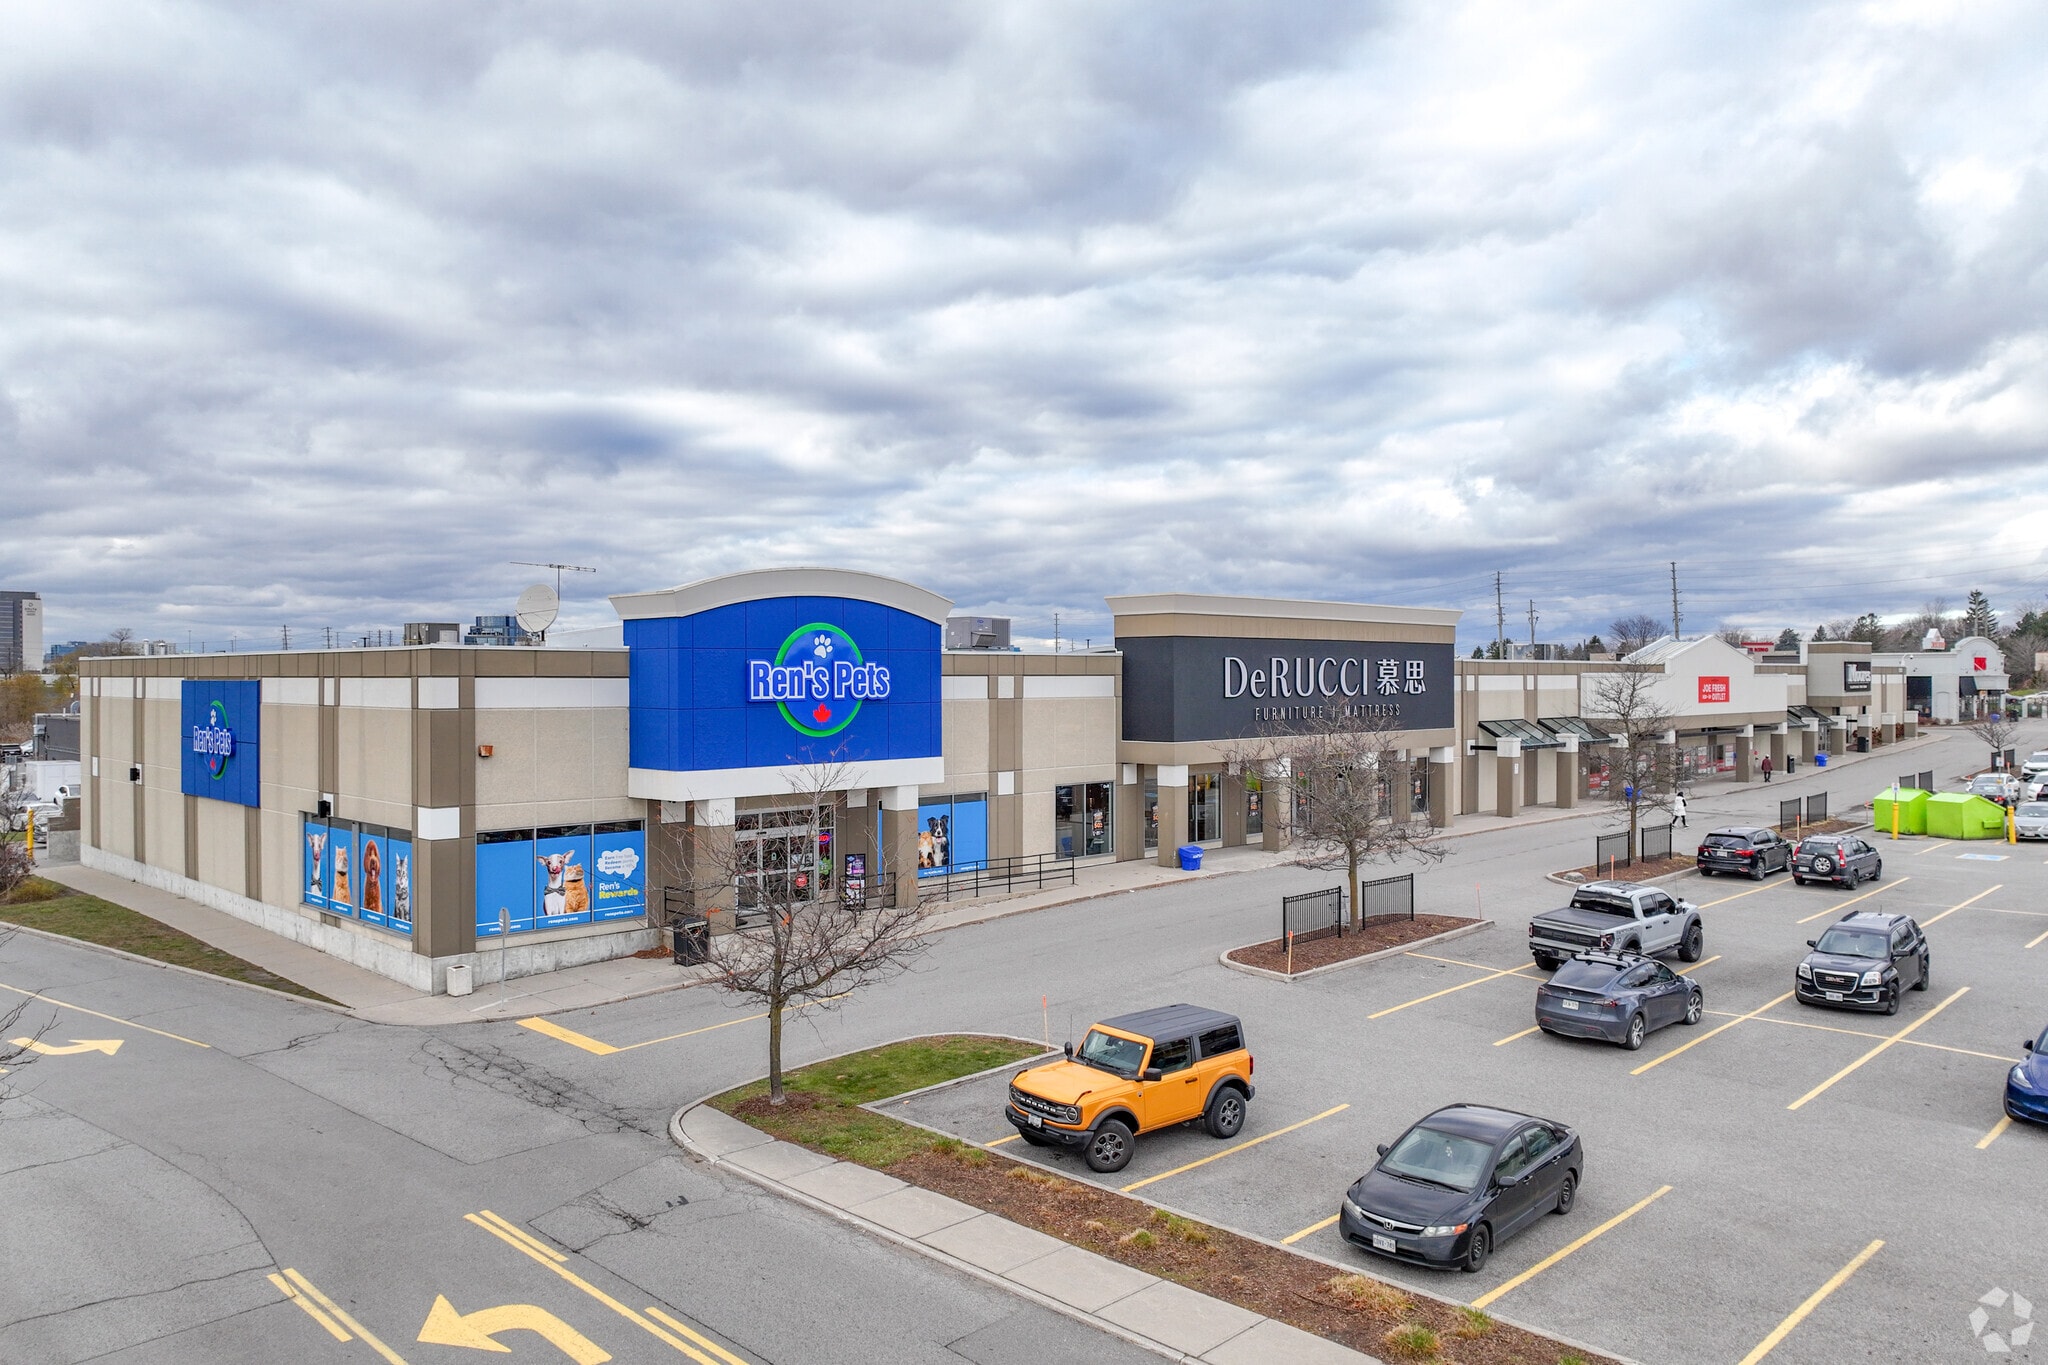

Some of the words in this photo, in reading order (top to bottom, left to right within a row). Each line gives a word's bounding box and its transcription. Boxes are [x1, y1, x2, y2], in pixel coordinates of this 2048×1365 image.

[750, 660, 829, 699] Ren's
[835, 660, 890, 699] Pets
[1225, 656, 1368, 698] DeRUCCI
[1376, 658, 1427, 696] 慕思
[1255, 705, 1324, 721] FURNITURE
[1345, 703, 1401, 718] MATTRESS
[193, 725, 213, 754] Ren's
[213, 727, 231, 756] Pets
[599, 881, 620, 891] Ren's
[599, 887, 639, 899] Rewards
